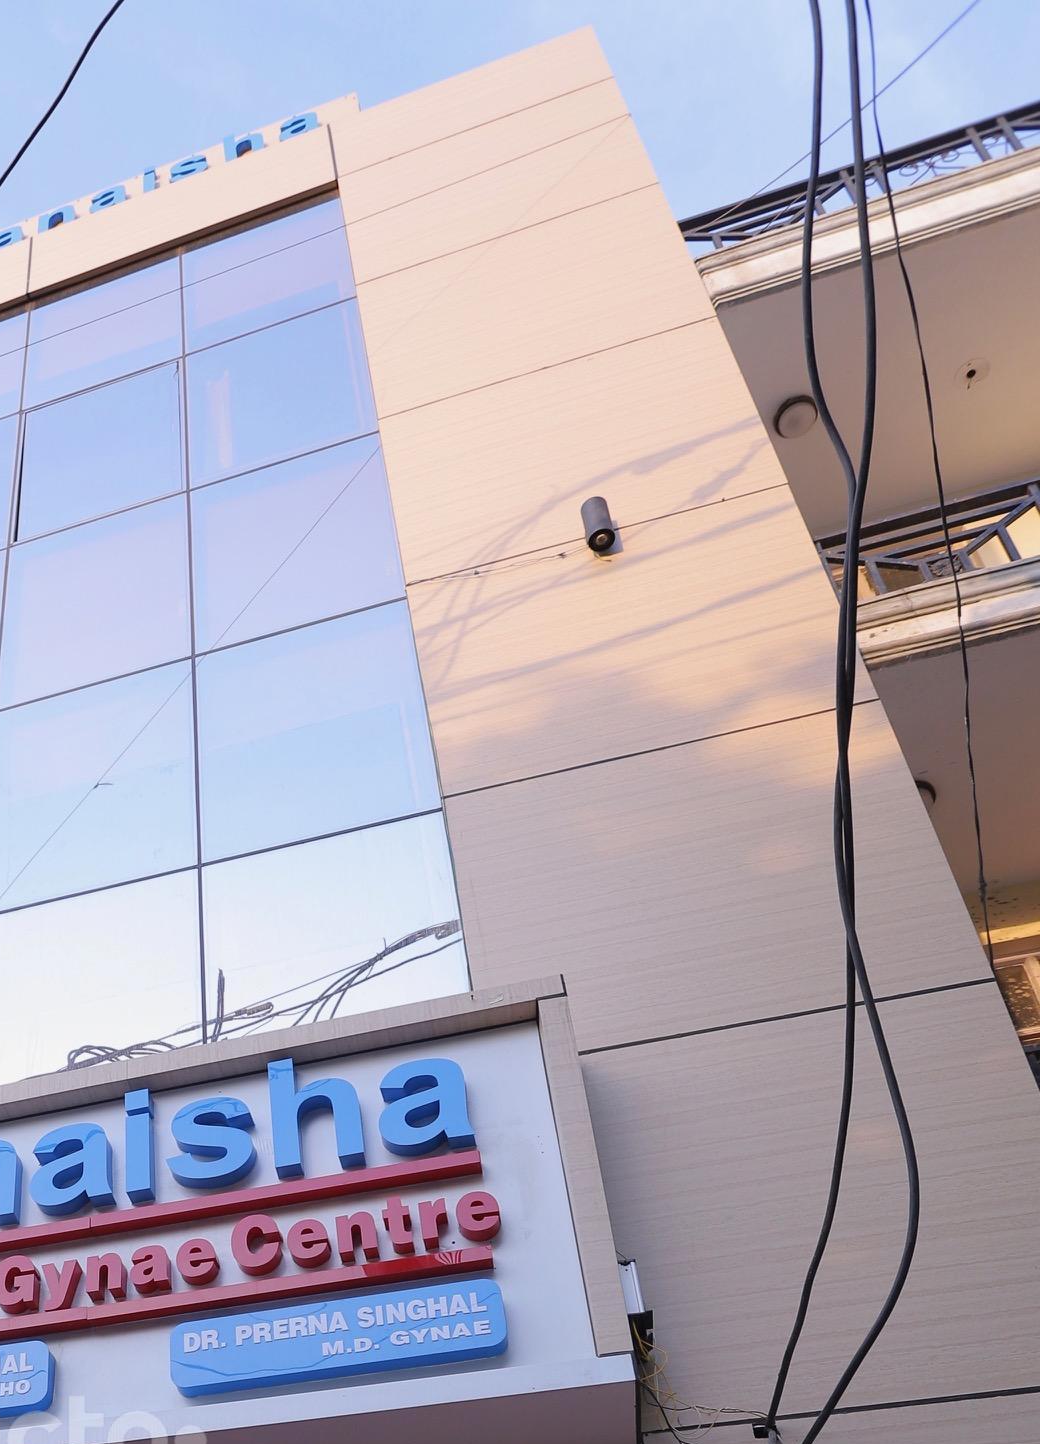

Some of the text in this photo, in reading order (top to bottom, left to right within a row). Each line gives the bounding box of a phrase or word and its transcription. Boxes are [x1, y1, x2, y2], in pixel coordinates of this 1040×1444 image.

[231, 1191, 501, 1276] Centre
[183, 1292, 488, 1353] DR. PRERNA SINGHAL
[322, 1320, 492, 1357] M.D. GYNAE
